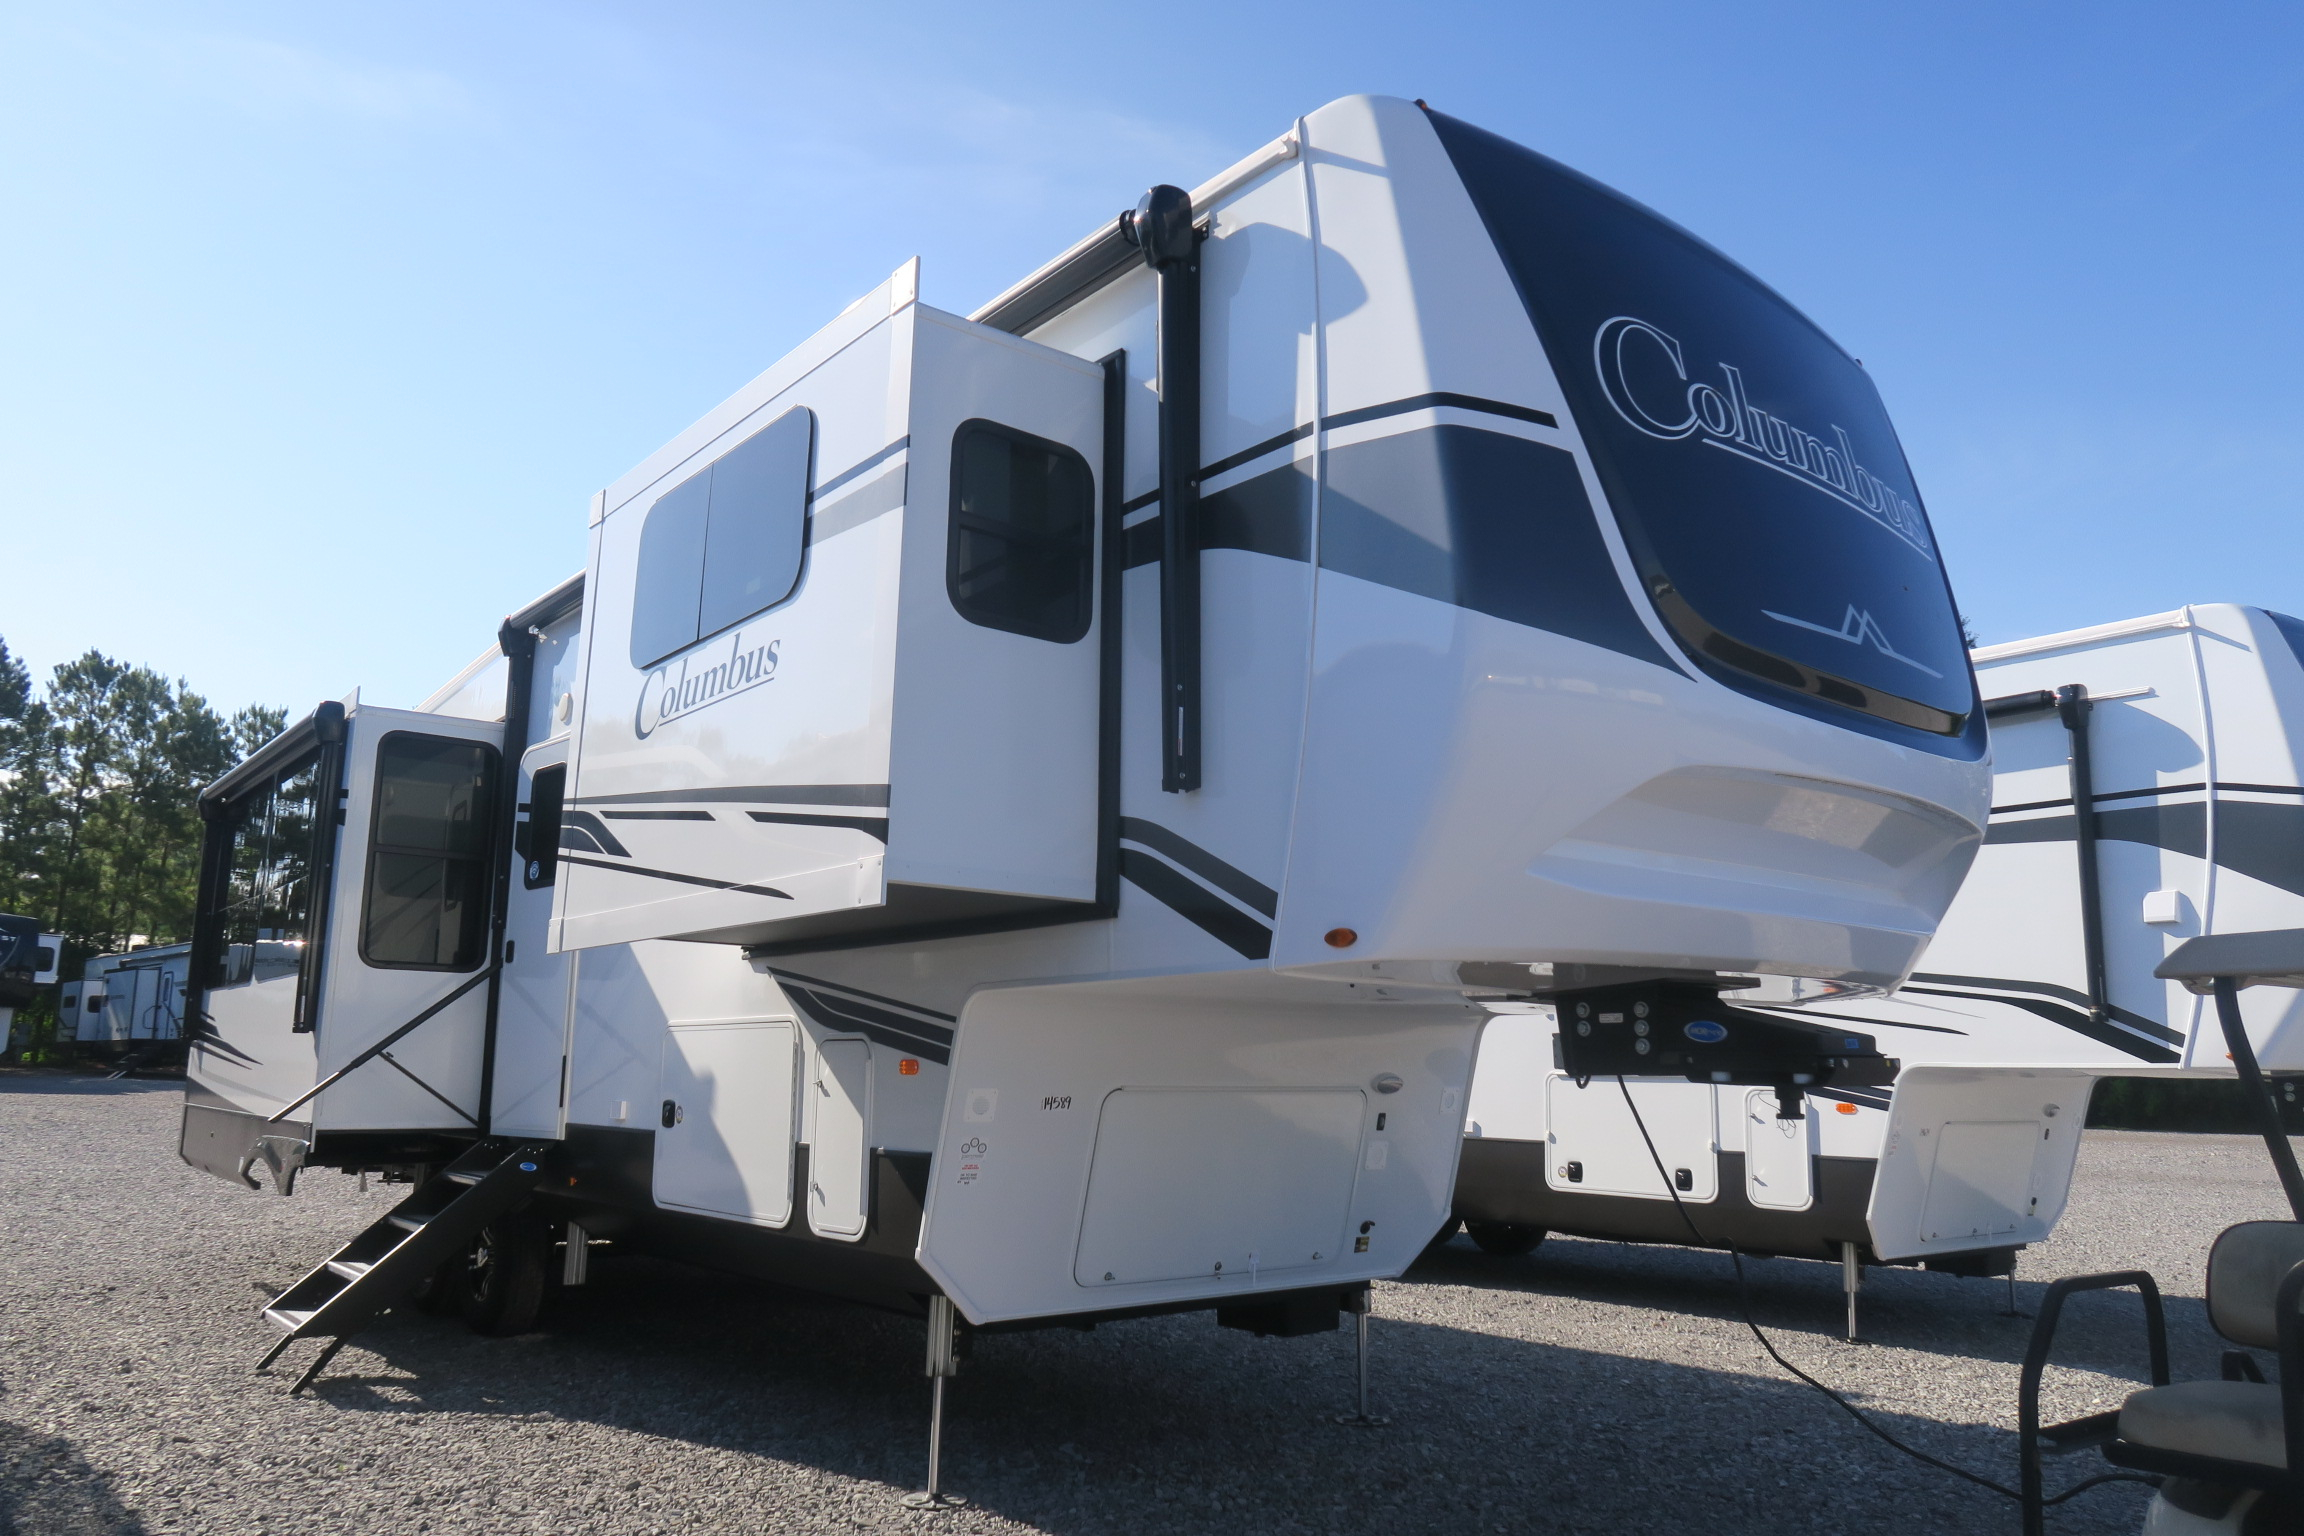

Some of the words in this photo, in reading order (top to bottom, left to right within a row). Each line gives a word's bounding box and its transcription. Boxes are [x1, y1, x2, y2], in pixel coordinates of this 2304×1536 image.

[1594, 316, 1929, 550] Columbus
[635, 632, 781, 740] Columbus
[1043, 1096, 1072, 1110] 14589
